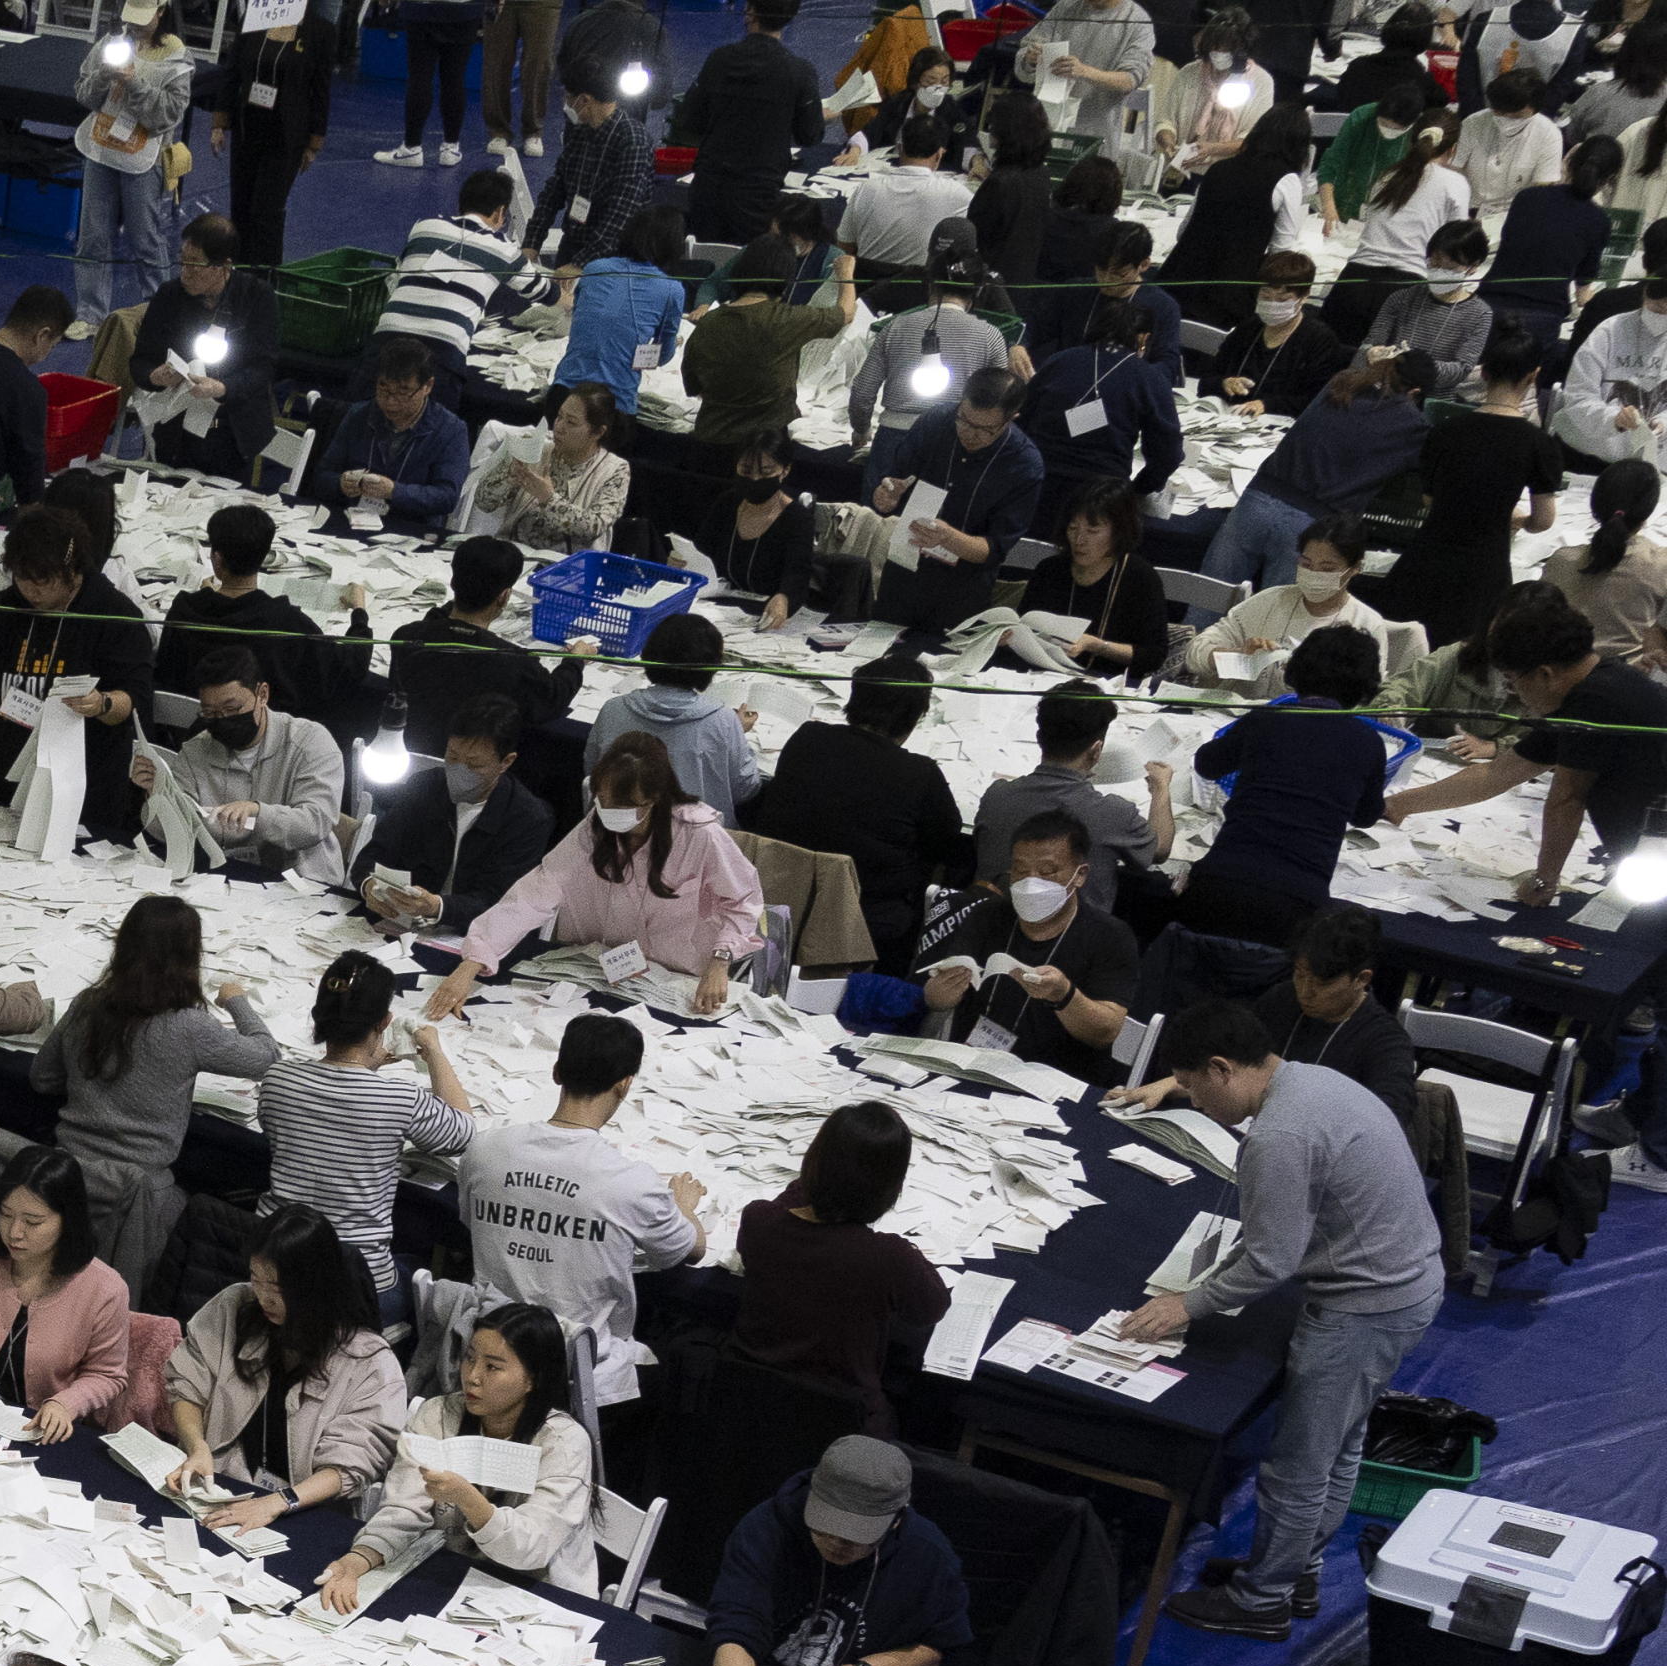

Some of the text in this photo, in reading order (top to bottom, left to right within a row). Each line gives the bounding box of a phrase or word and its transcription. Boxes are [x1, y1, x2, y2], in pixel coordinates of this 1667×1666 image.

[504, 1171, 580, 1199] ATHLETIC
[475, 1199, 607, 1242] UNBROKEN
[507, 1241, 554, 1263] SEOUL
